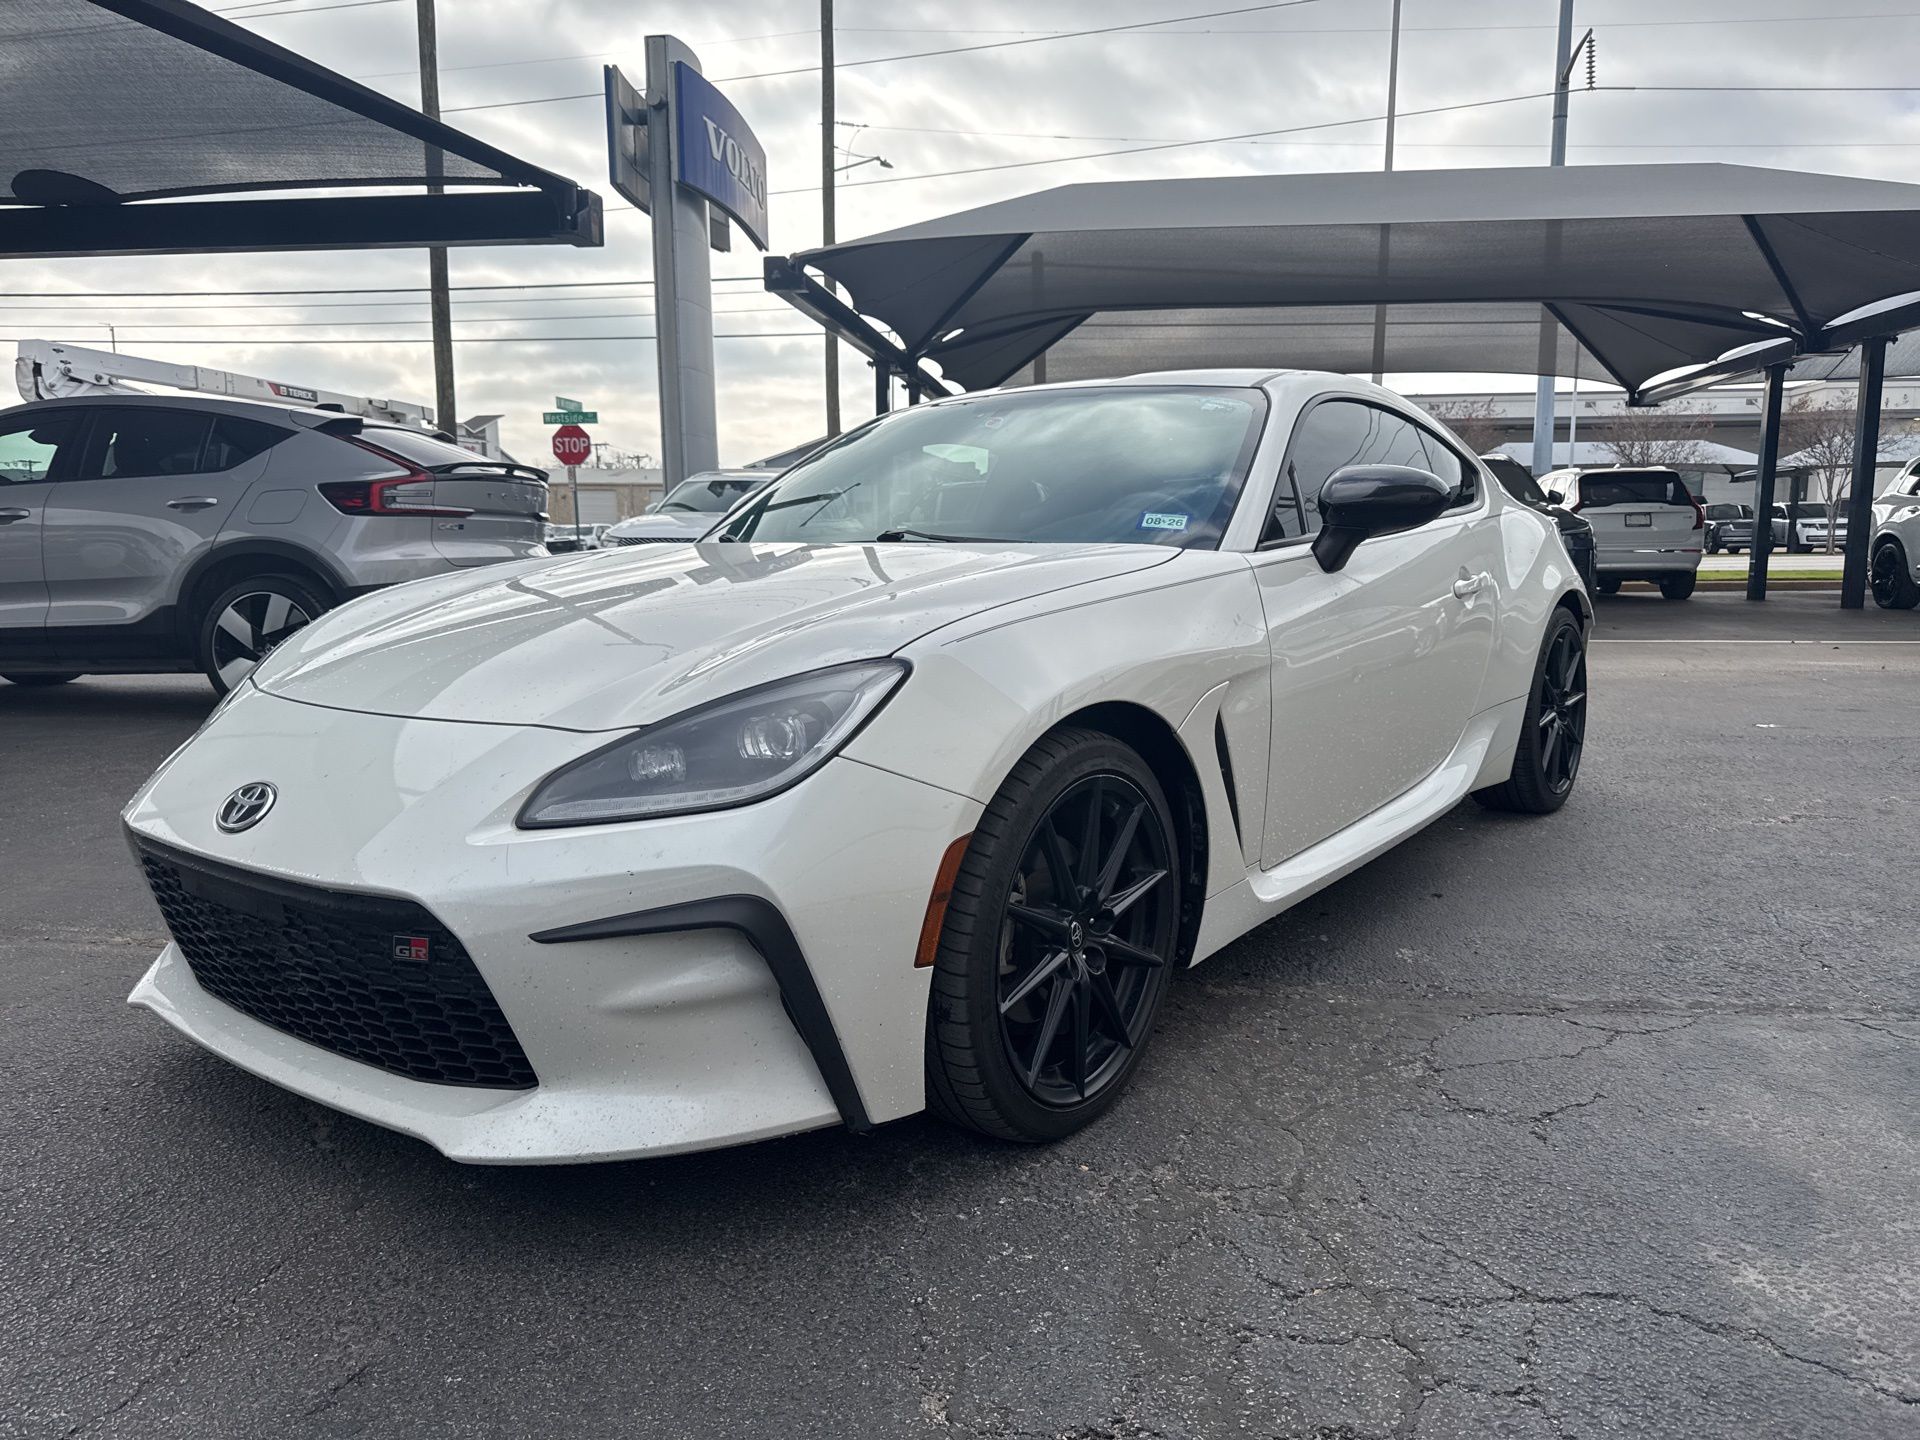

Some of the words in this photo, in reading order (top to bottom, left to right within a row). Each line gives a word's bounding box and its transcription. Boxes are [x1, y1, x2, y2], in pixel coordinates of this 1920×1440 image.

[703, 115, 765, 210] VOLVO
[288, 388, 313, 400] TEREX
[544, 413, 584, 424] Westside
[555, 437, 588, 453] STOP
[395, 945, 426, 959] GR
